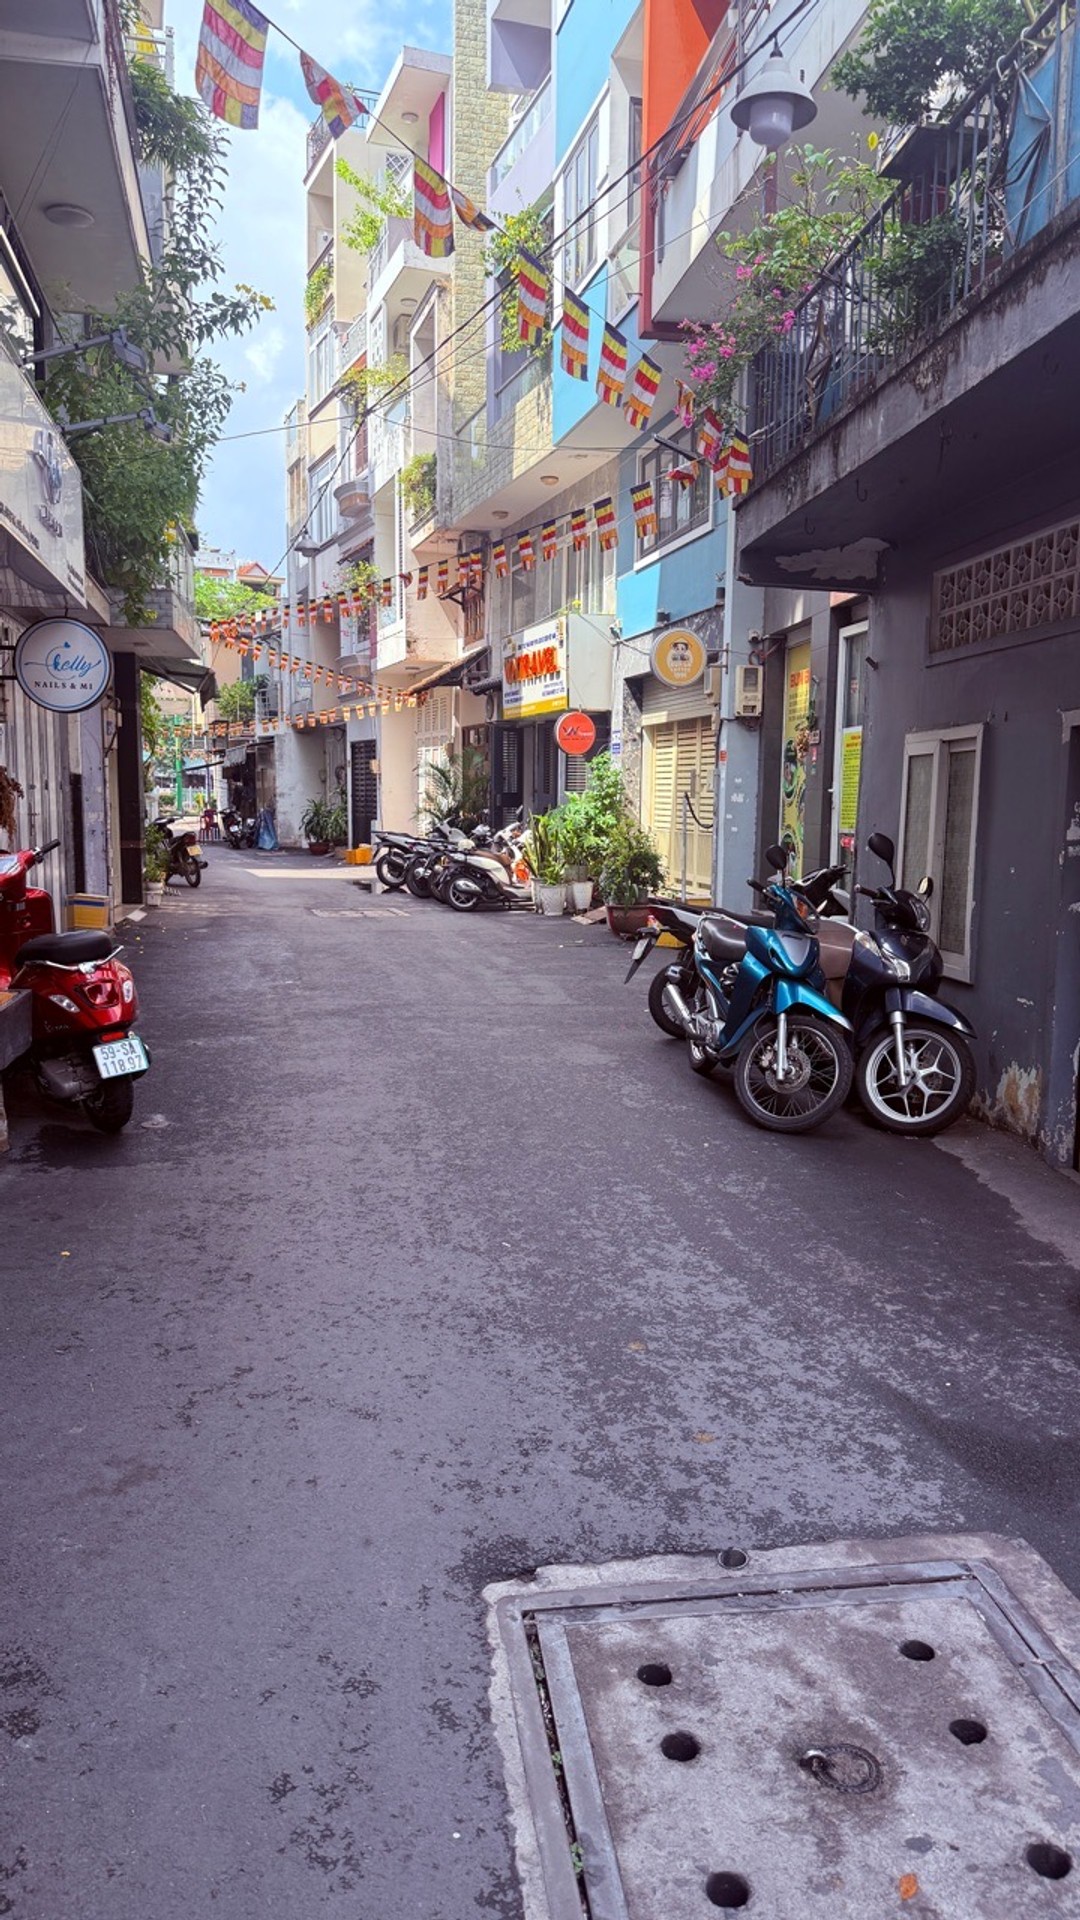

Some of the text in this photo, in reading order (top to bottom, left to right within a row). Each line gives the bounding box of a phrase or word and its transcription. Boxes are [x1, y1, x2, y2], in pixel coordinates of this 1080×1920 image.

[34, 680, 67, 689] NAILS
[80, 682, 93, 690] MI
[100, 1040, 137, 1060] 59-SA
[102, 1055, 142, 1075] 118.97
